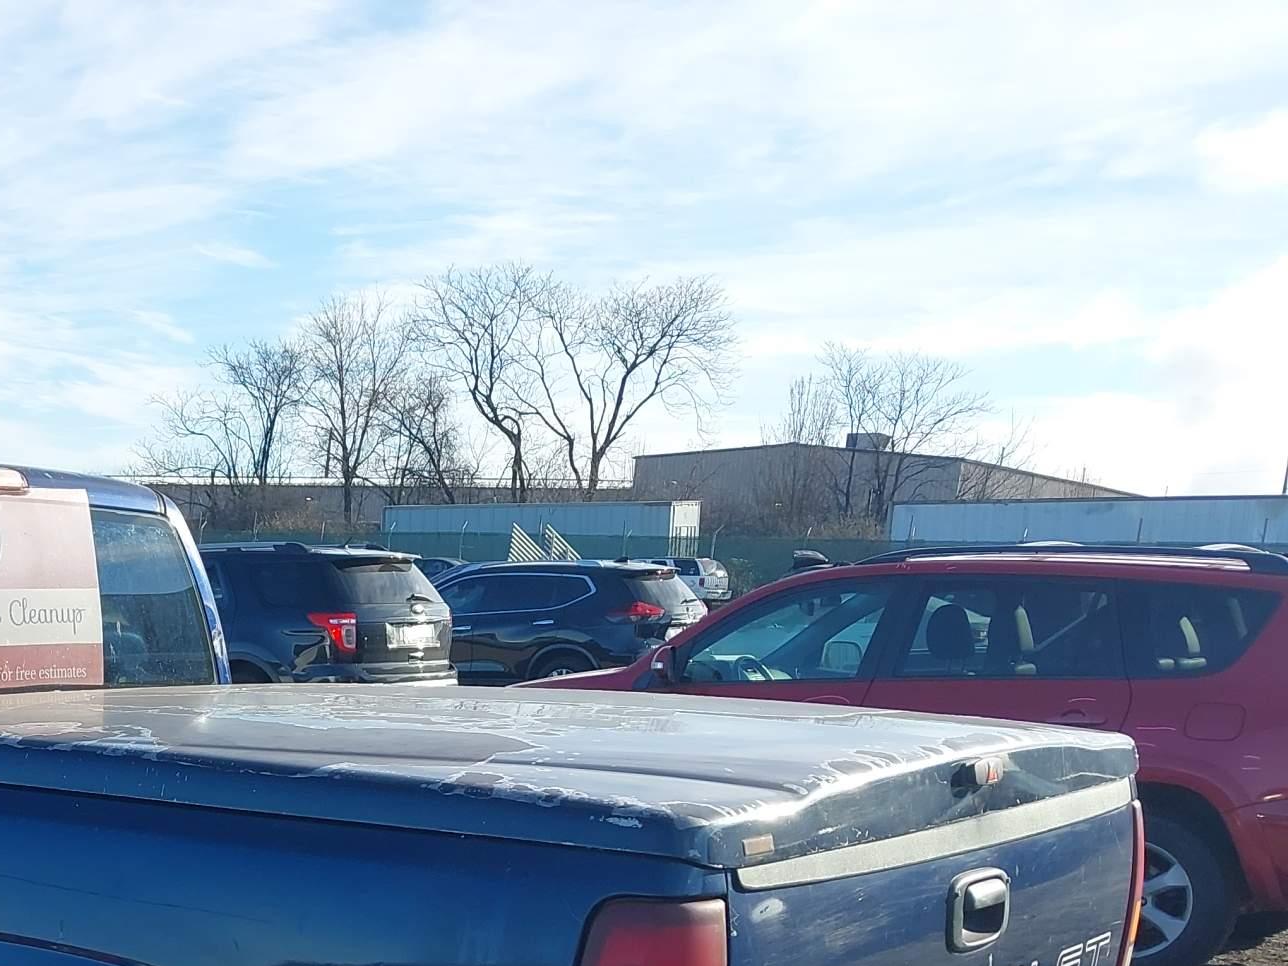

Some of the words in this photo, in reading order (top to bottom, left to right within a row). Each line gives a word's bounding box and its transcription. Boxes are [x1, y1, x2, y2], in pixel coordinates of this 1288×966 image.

[8, 598, 87, 636] Cleanup
[15, 666, 37, 681] free
[38, 664, 88, 680] estimates
